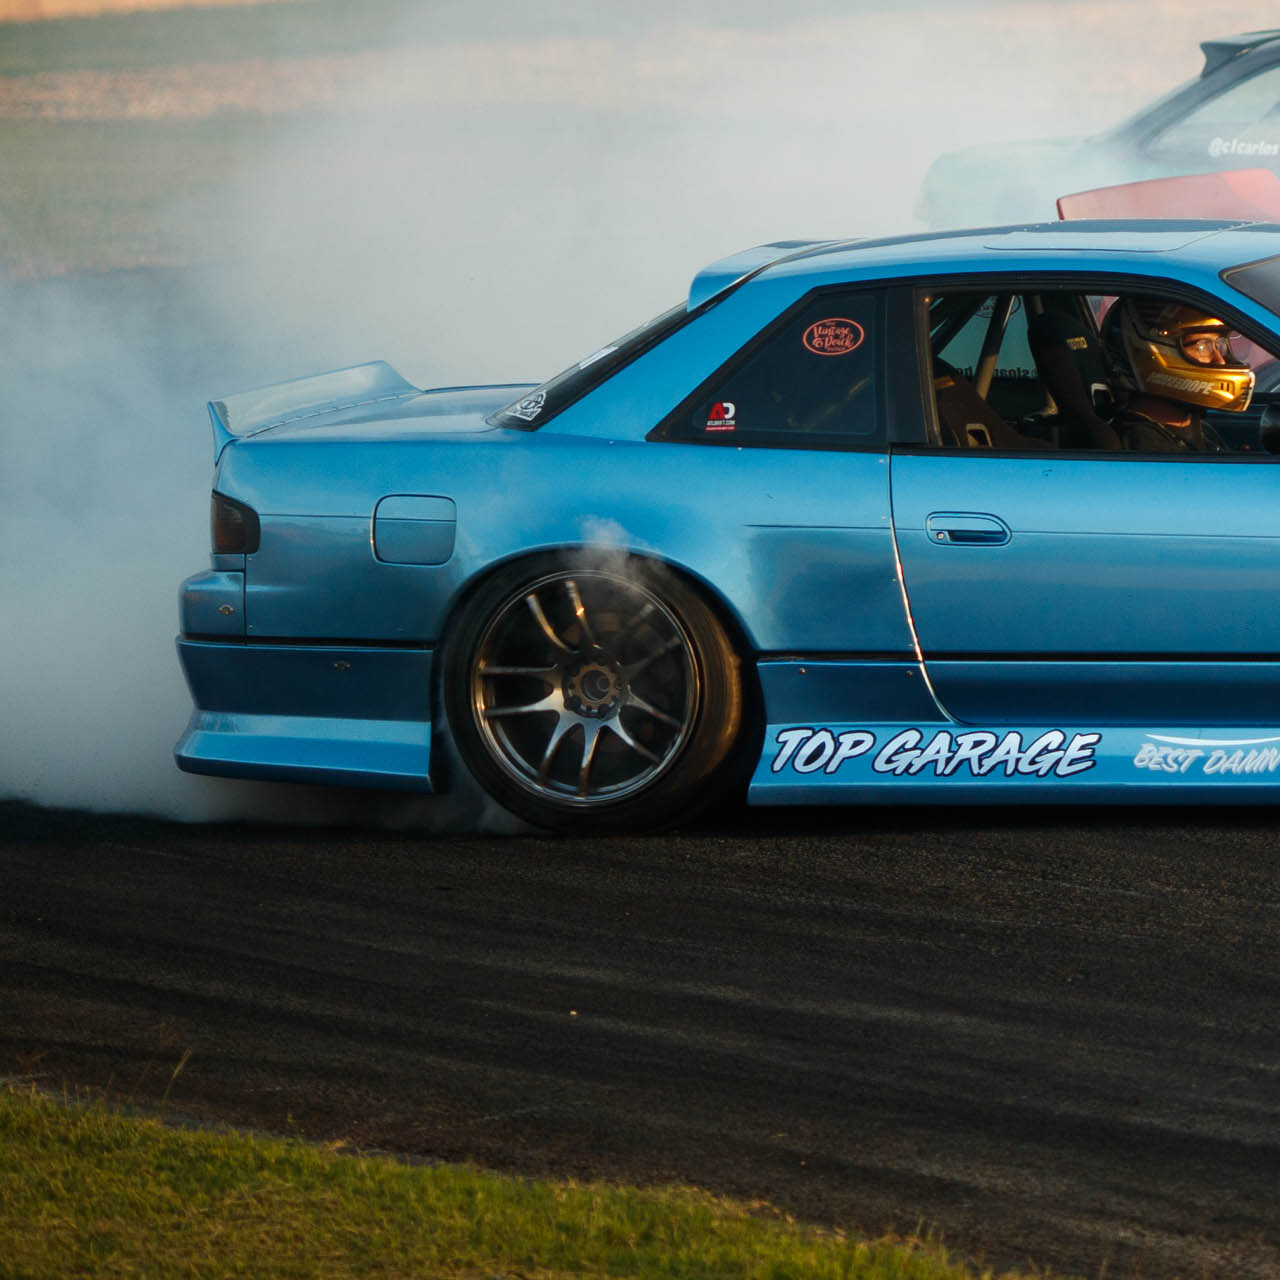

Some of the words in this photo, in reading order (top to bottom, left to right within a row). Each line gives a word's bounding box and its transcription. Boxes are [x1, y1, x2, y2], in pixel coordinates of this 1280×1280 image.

[772, 727, 876, 774] TOP
[872, 728, 1102, 777] GARAGE
[1133, 743, 1204, 774] BEST
